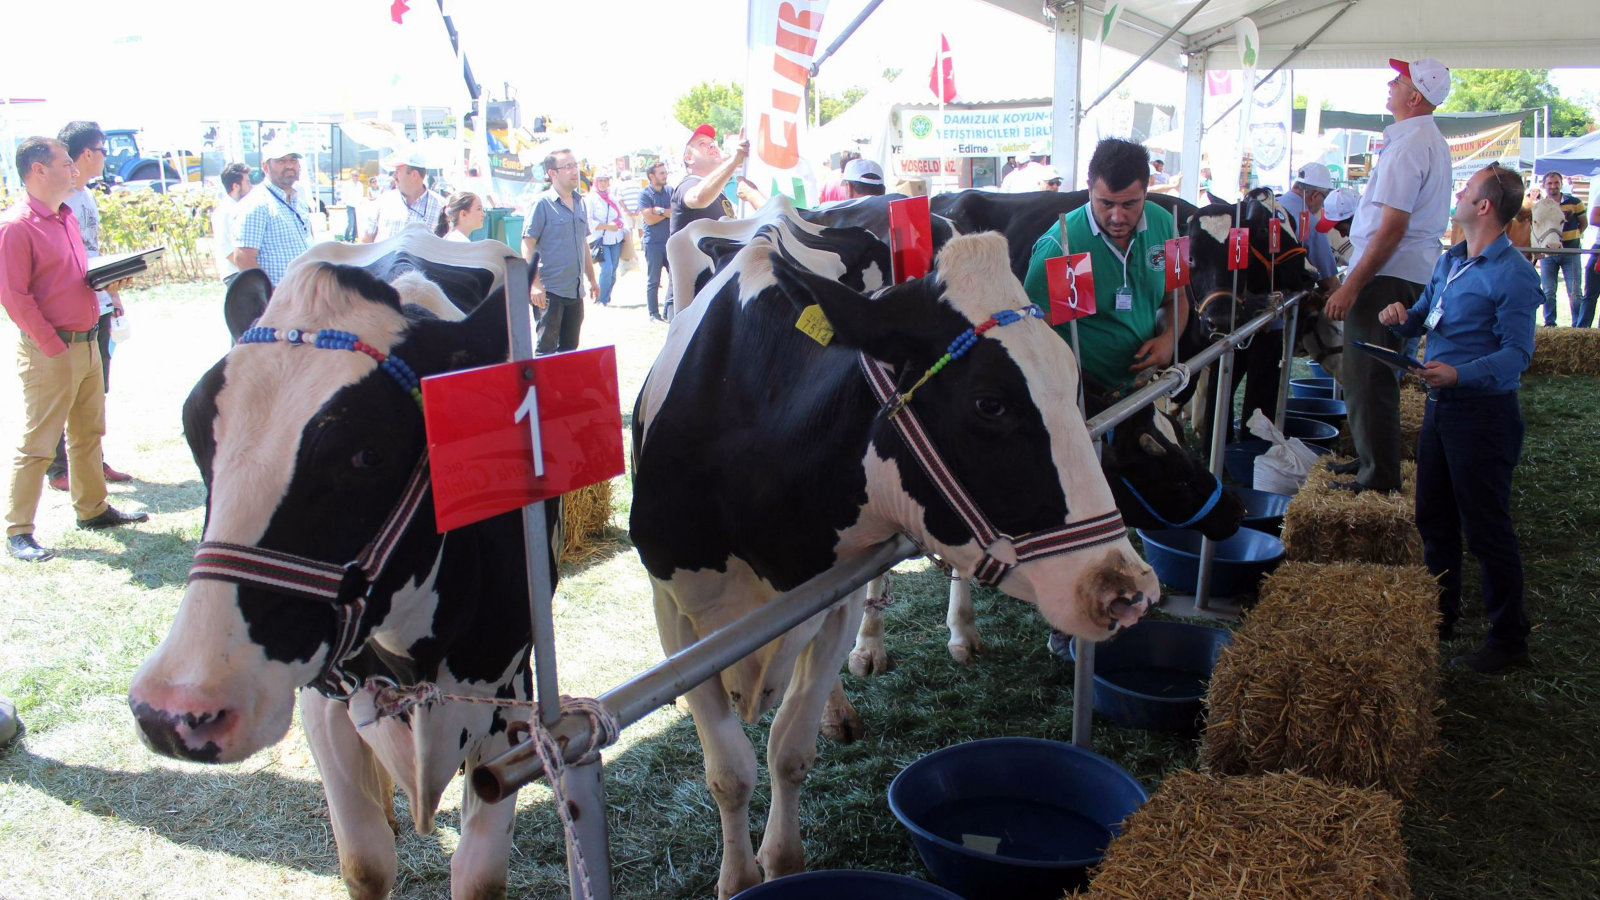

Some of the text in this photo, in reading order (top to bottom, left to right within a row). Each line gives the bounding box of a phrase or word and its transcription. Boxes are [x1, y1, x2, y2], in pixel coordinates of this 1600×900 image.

[944, 112, 1052, 124] DAMIZLIK KOYUN-
[1175, 248, 1180, 280] 4
[1236, 237, 1241, 264] 5
[1066, 267, 1078, 309] 3
[514, 385, 545, 477] 1
